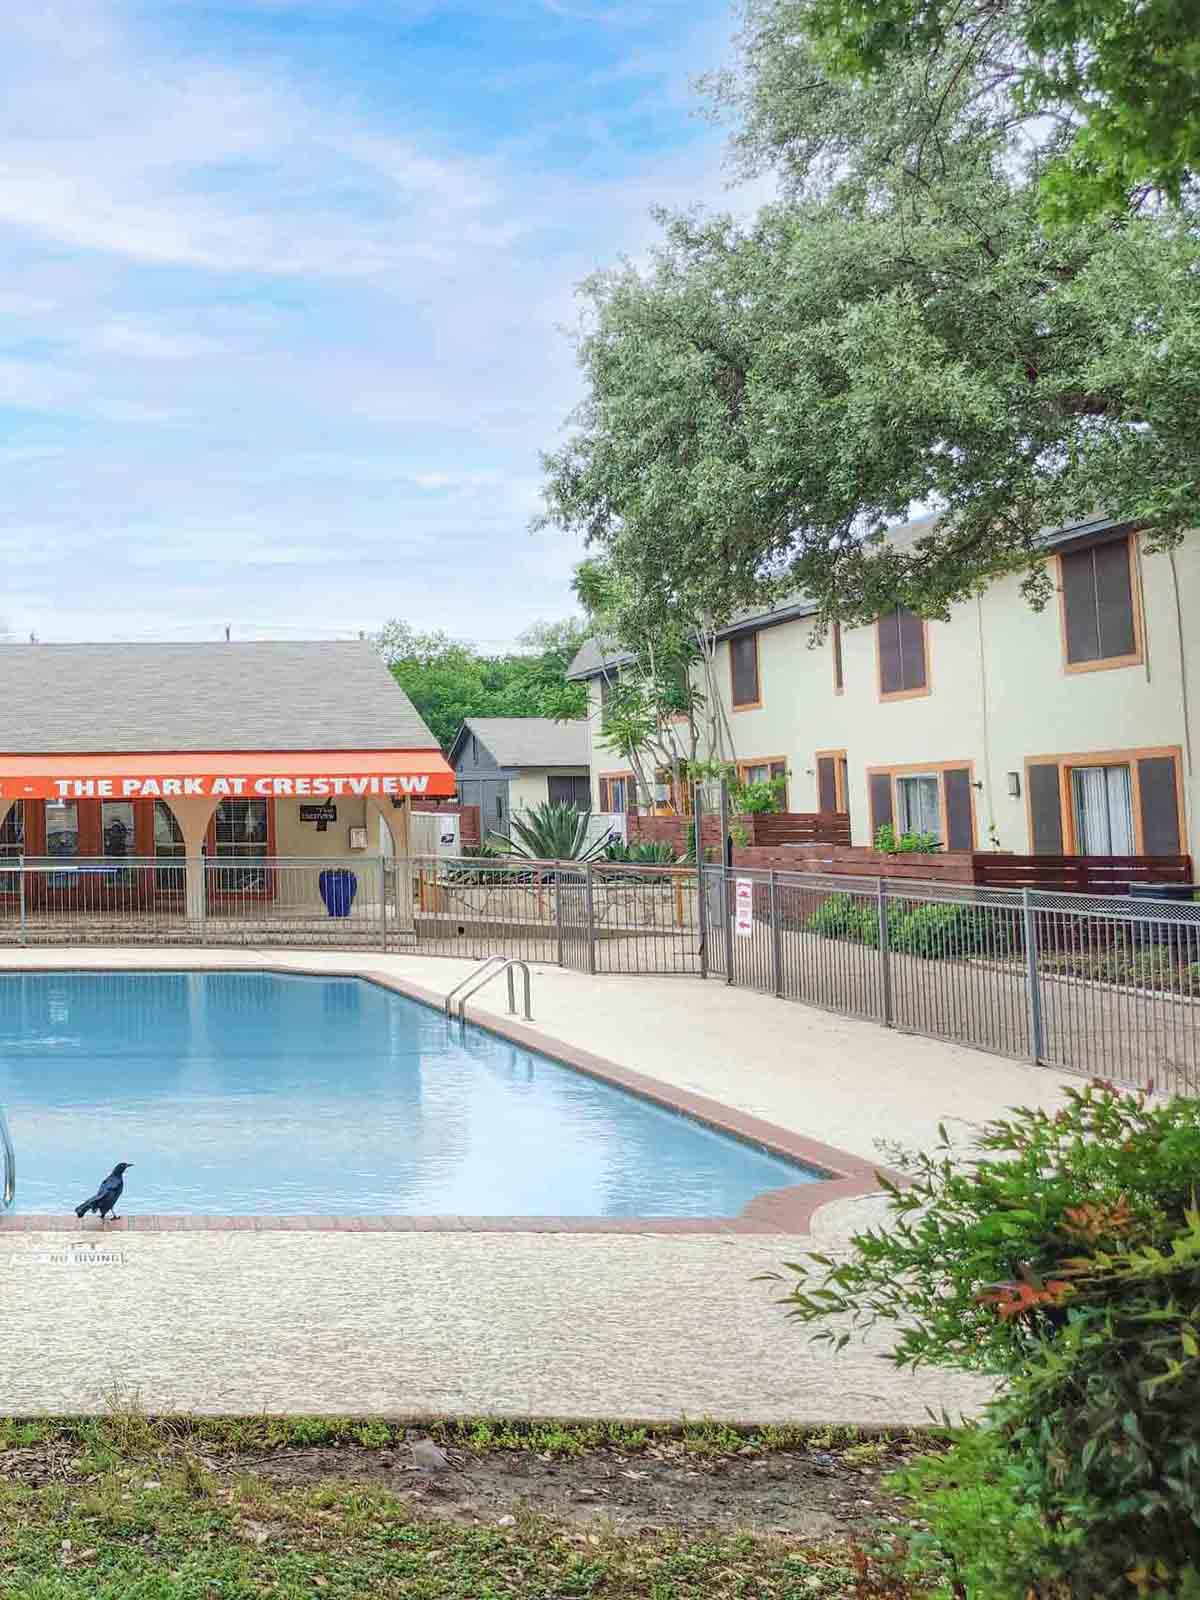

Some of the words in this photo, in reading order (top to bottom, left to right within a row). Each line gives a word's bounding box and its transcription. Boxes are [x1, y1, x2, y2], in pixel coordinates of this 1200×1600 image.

[54, 779, 113, 796] THE
[122, 778, 203, 796] PARK
[211, 777, 247, 795] AT
[254, 776, 429, 795] CRESTVIEW
[73, 1254, 120, 1263] DIVING
